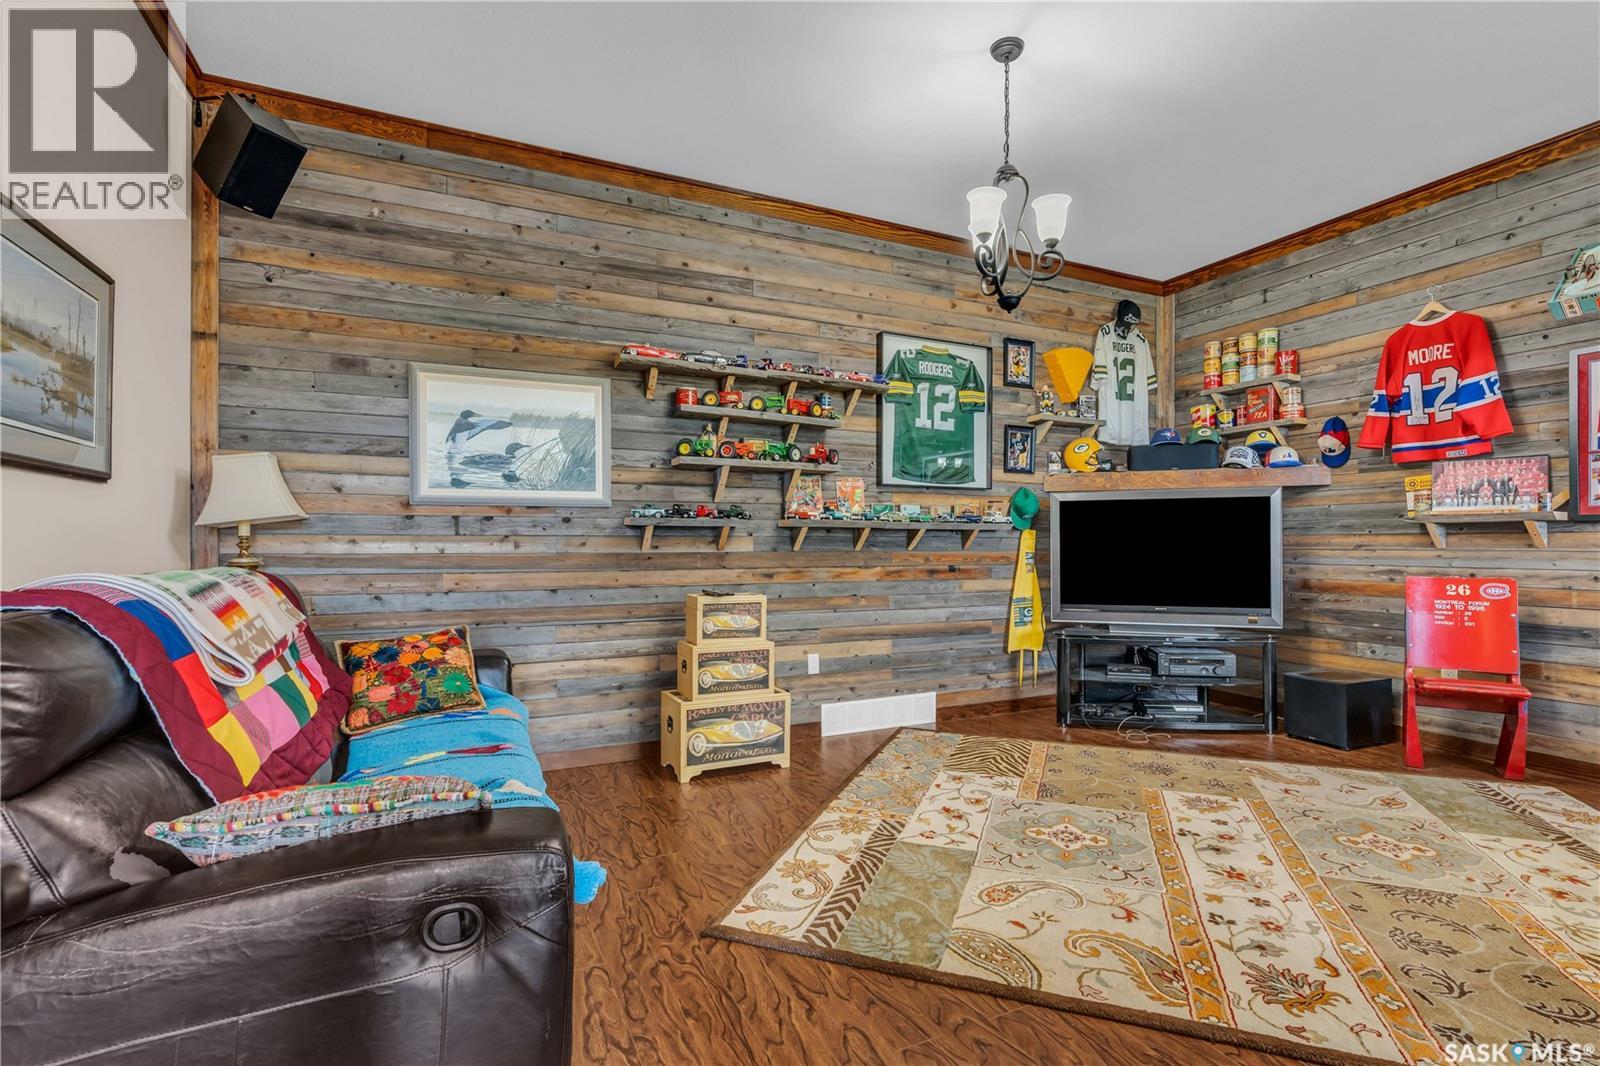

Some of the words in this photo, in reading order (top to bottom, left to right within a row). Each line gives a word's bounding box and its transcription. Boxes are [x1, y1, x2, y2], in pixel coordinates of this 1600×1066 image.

[1407, 343, 1455, 366] MOORE
[918, 360, 953, 378] RODGERS
[1403, 366, 1459, 426] 12
[1480, 376, 1501, 400] 12
[915, 382, 957, 432] 12
[1446, 584, 1471, 596] 26
